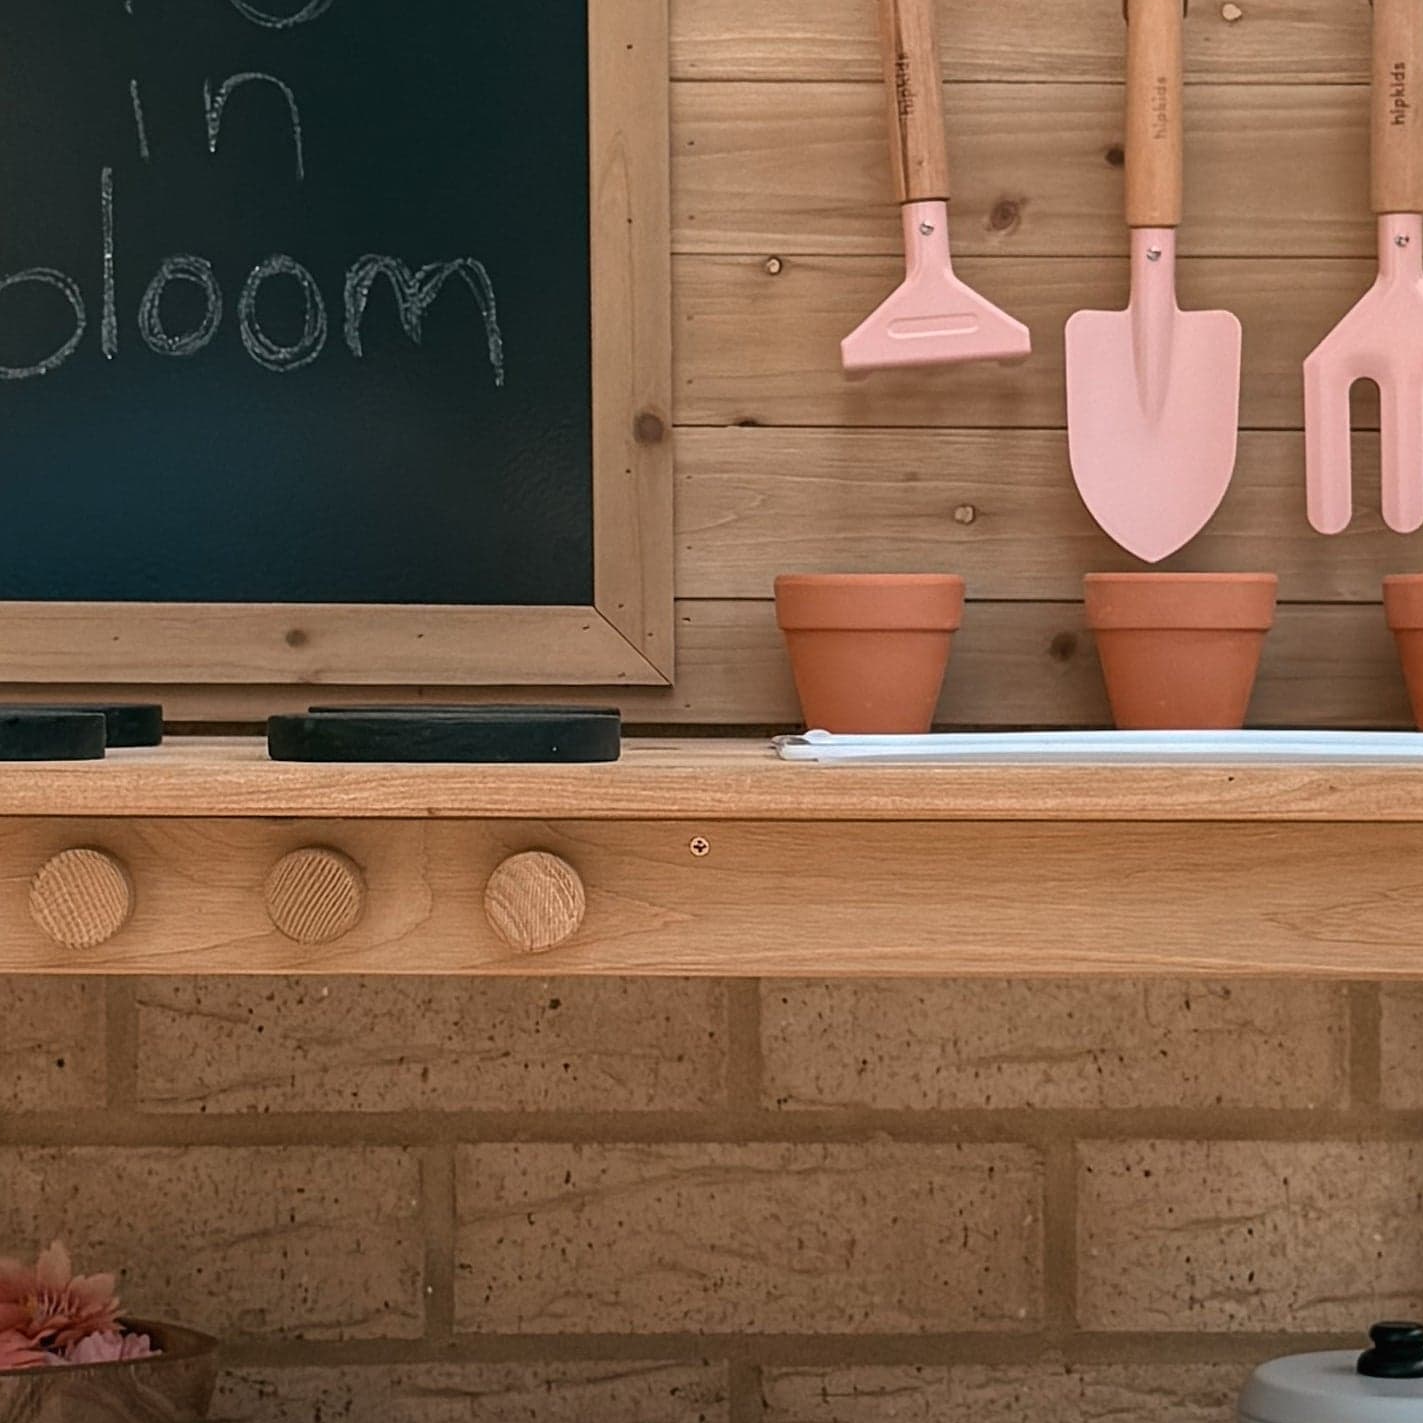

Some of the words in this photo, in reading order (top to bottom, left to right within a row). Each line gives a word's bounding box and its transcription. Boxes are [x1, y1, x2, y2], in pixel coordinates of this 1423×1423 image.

[125, 0, 304, 179] in
[1151, 76, 1169, 140] hipkids
[1389, 61, 1410, 126] hipkids
